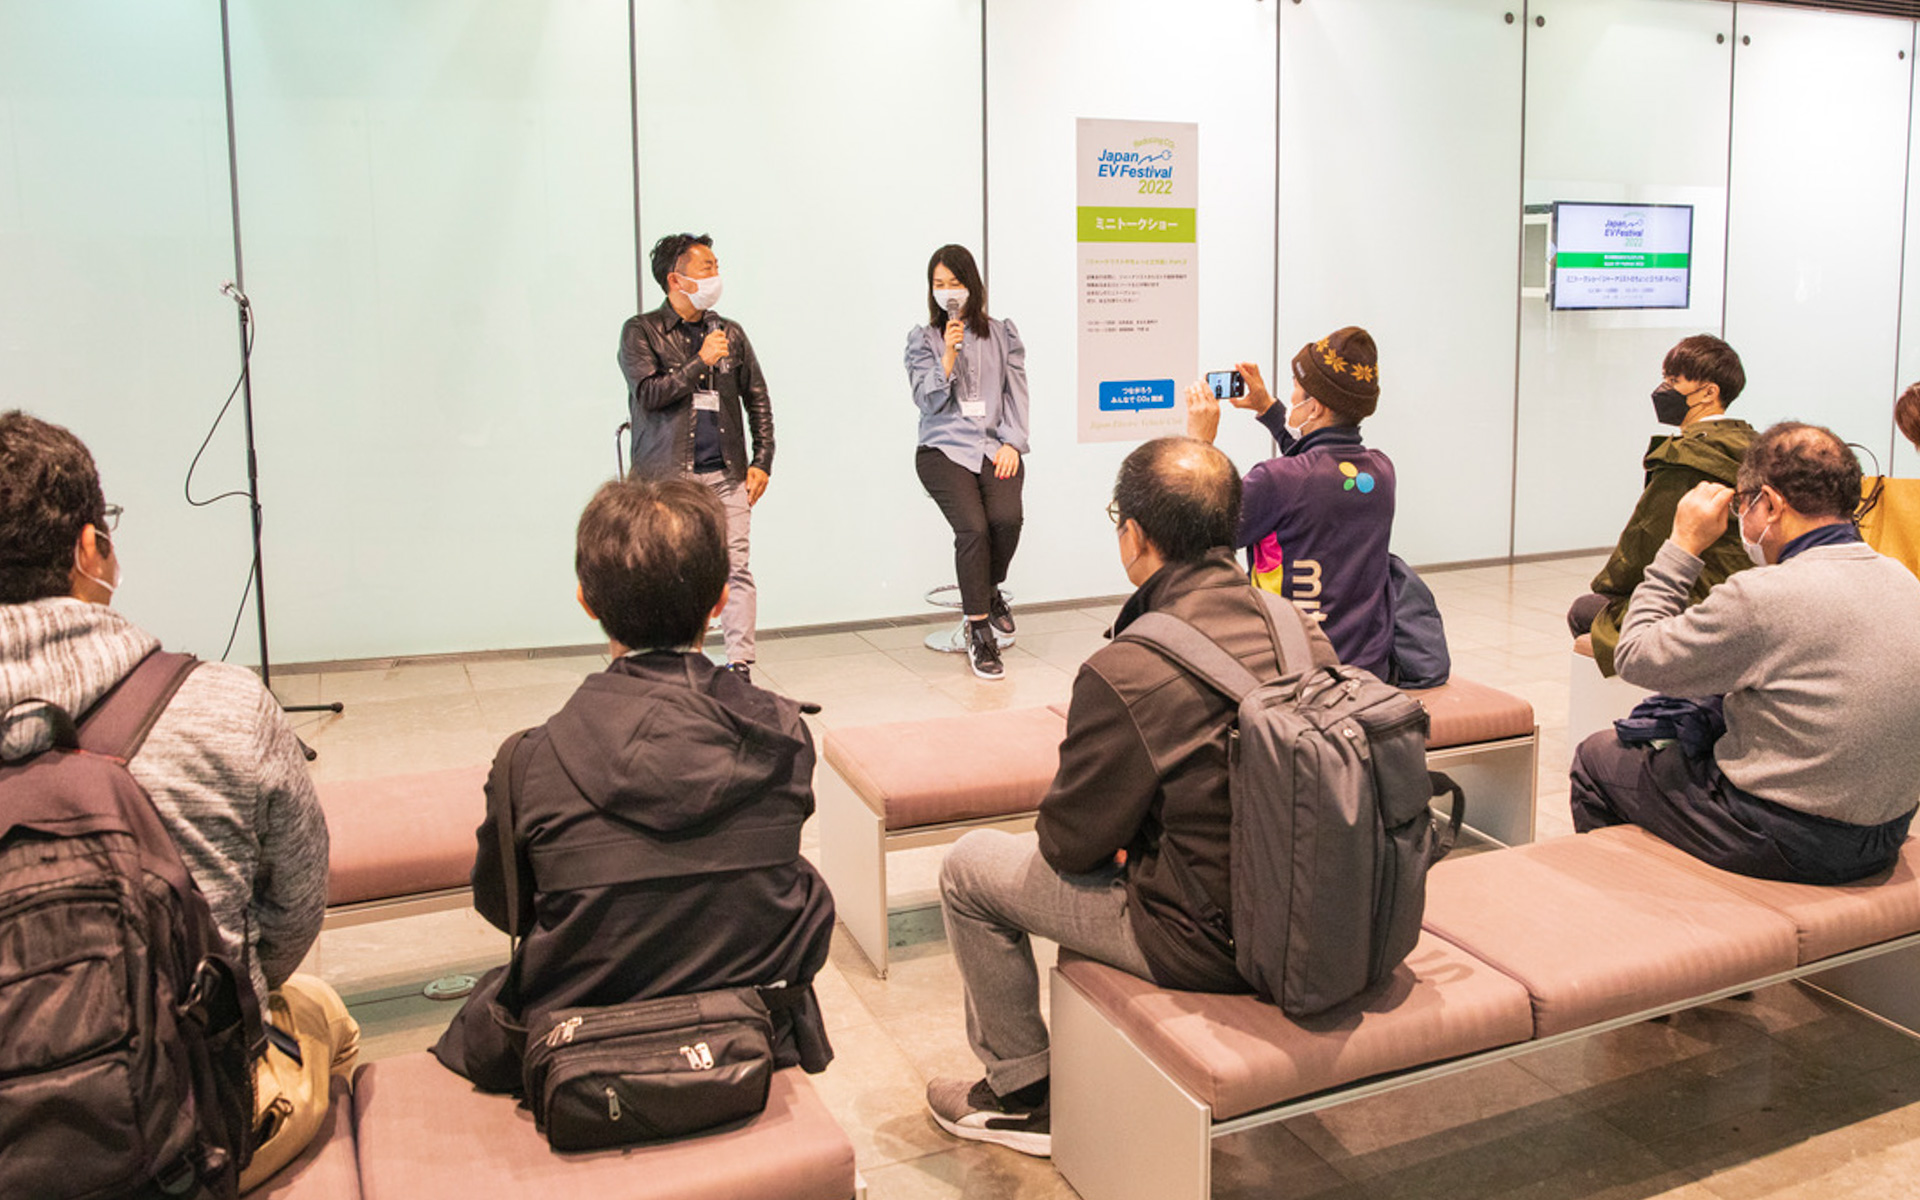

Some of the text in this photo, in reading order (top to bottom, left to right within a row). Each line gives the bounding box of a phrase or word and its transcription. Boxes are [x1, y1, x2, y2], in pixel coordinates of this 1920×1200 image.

[1098, 149, 1138, 164] Japan
[1097, 164, 1173, 178] EV Festival
[1138, 179, 1173, 194] 2022
[1096, 217, 1178, 230] ミニトークショー
[1605, 220, 1626, 228] Japan
[1604, 228, 1644, 237] EV Festival
[1625, 238, 1644, 248] 2022
[1122, 387, 1152, 395] つながろう
